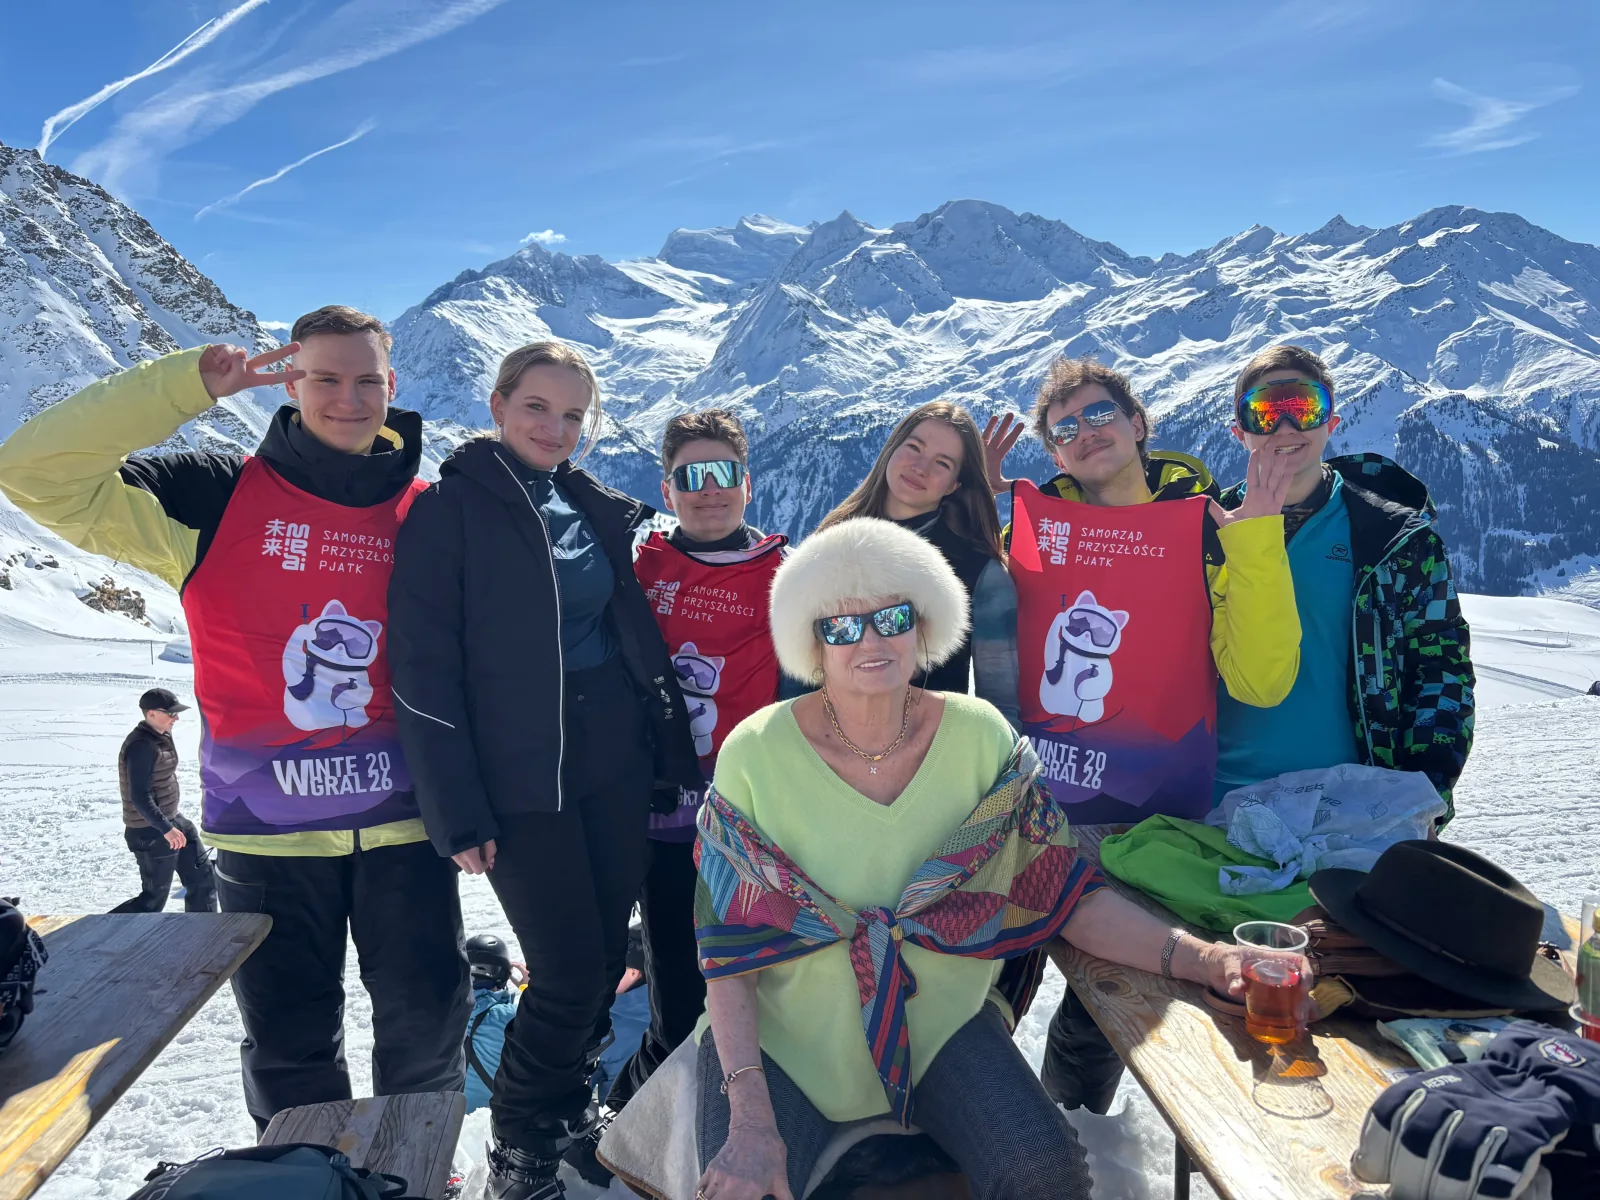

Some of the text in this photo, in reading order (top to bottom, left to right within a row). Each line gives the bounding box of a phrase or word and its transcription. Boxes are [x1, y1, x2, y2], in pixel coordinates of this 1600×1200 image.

[323, 530, 391, 549] SAMORZĄD
[1081, 527, 1143, 543] SAMORZĄD
[1078, 541, 1165, 558] PRZYSZŁOŚCI
[319, 560, 364, 574] PJATK
[1075, 555, 1114, 567] PJATK
[688, 585, 738, 601] SAMORZĄD
[683, 596, 755, 617] PRZYSZŁOŚCI
[681, 609, 714, 623] PJATK
[365, 751, 391, 776] 20
[1085, 749, 1107, 771] 20
[368, 769, 393, 792] 26
[1081, 766, 1102, 790] 26
